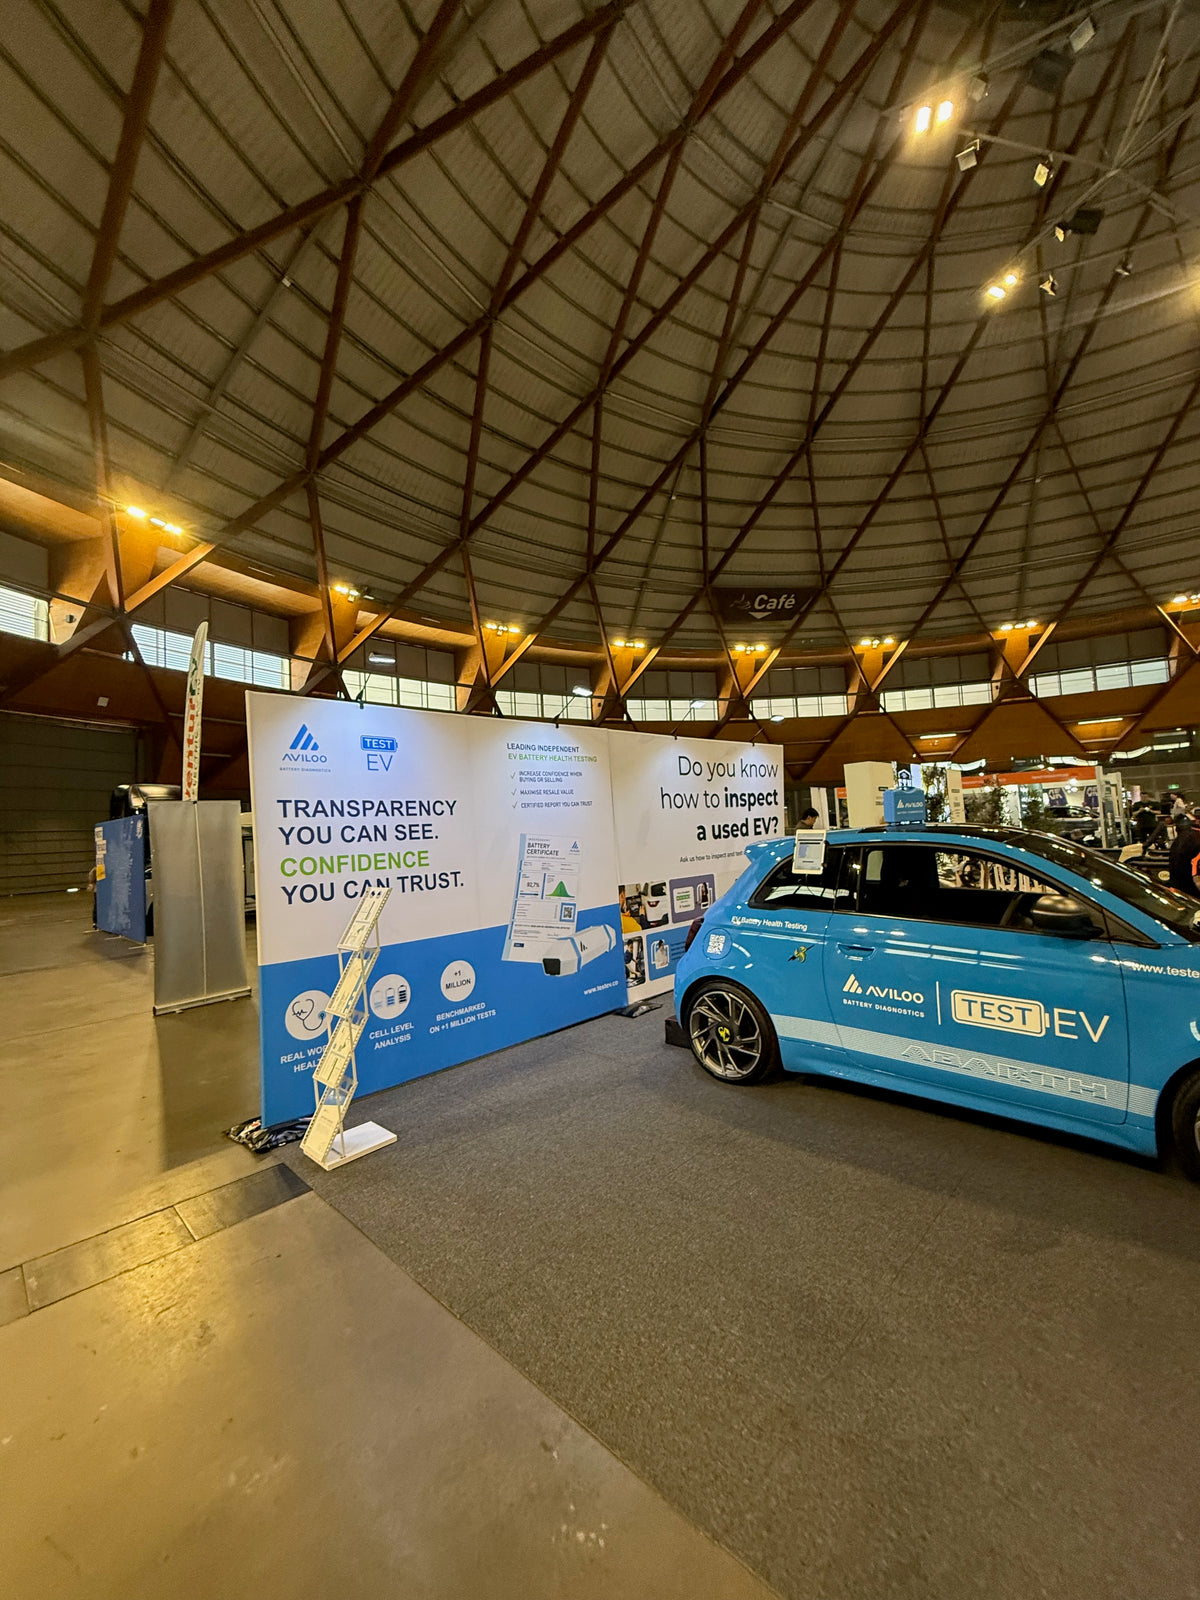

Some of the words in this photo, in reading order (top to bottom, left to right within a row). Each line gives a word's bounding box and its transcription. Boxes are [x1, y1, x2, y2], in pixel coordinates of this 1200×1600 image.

[754, 593, 796, 610] Café
[364, 738, 393, 749] TEST
[506, 742, 537, 751] LEADING
[537, 745, 580, 753] INDEPENDENT
[282, 753, 328, 763] AVILOO
[367, 753, 394, 772] EV
[519, 753, 548, 761] BATTERY
[678, 756, 703, 776] Do
[707, 761, 736, 782] you
[740, 758, 778, 778] know
[660, 787, 699, 809] how
[703, 790, 720, 808] to
[724, 786, 778, 811] inspect
[277, 799, 457, 818] TRANSPARENCY
[278, 826, 332, 846] YOU
[340, 825, 387, 843] CAN
[394, 823, 439, 841] SEE.
[696, 824, 706, 841] a
[711, 818, 749, 840] used
[753, 816, 779, 836] EV?
[526, 848, 560, 857] CERTIFICATE
[711, 852, 727, 860] inspect
[280, 850, 429, 877] CONFIDENCE
[281, 884, 335, 905] YOU
[343, 877, 390, 899] CAN
[396, 871, 465, 893] TRUST.
[741, 917, 762, 926] Battery
[762, 919, 783, 928] Health
[785, 921, 808, 932] Testing
[454, 969, 462, 977] +1
[445, 978, 472, 990] MILLION
[865, 985, 924, 1004] AVILOO
[436, 1002, 486, 1021] BENCHMARKED
[842, 998, 873, 1009] BATTERY
[874, 1004, 925, 1018] DIAGNOSTICS
[429, 1026, 440, 1034] ON
[441, 1022, 449, 1030] +1
[450, 1016, 477, 1028] MILLION
[477, 1009, 497, 1020] TESTS
[961, 998, 1033, 1026] TEST
[1053, 1007, 1110, 1043] EV
[369, 1029, 390, 1040] CELL
[390, 1022, 414, 1034] LEVEL
[374, 1033, 412, 1050] ANALYSIS
[280, 1051, 306, 1065] REAL
[307, 1044, 329, 1057] WOR
[293, 1058, 321, 1073] HEAL
[901, 1044, 1108, 1101] ABARTH
